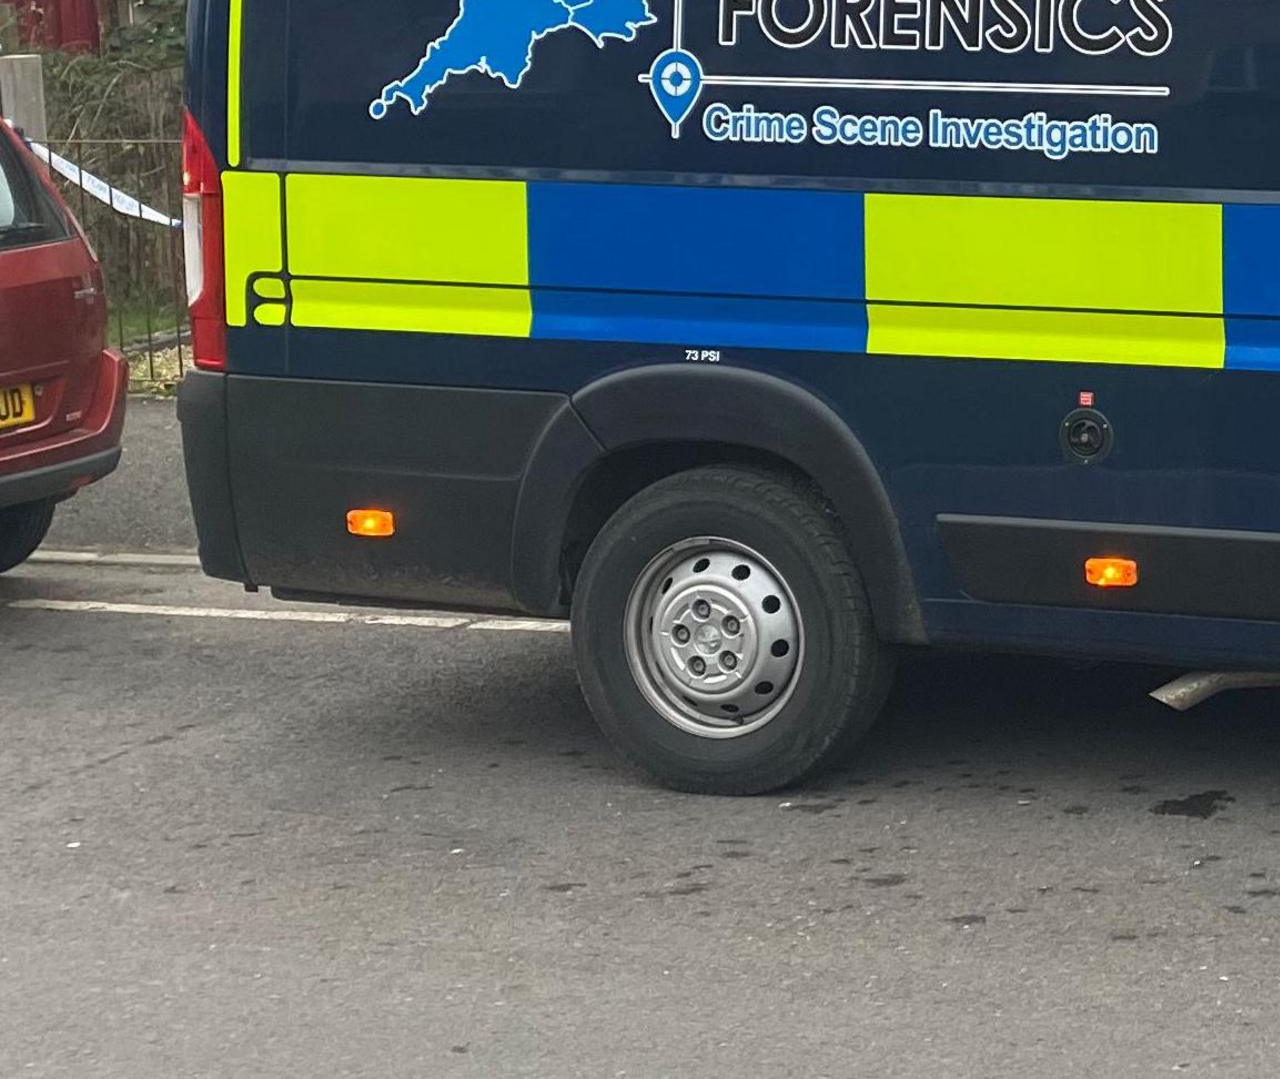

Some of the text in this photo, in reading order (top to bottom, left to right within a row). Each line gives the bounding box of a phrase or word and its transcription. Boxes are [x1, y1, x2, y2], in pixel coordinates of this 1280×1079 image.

[702, 102, 1158, 159] Crime Scene Investigation
[685, 349, 720, 362] 73 PSI
